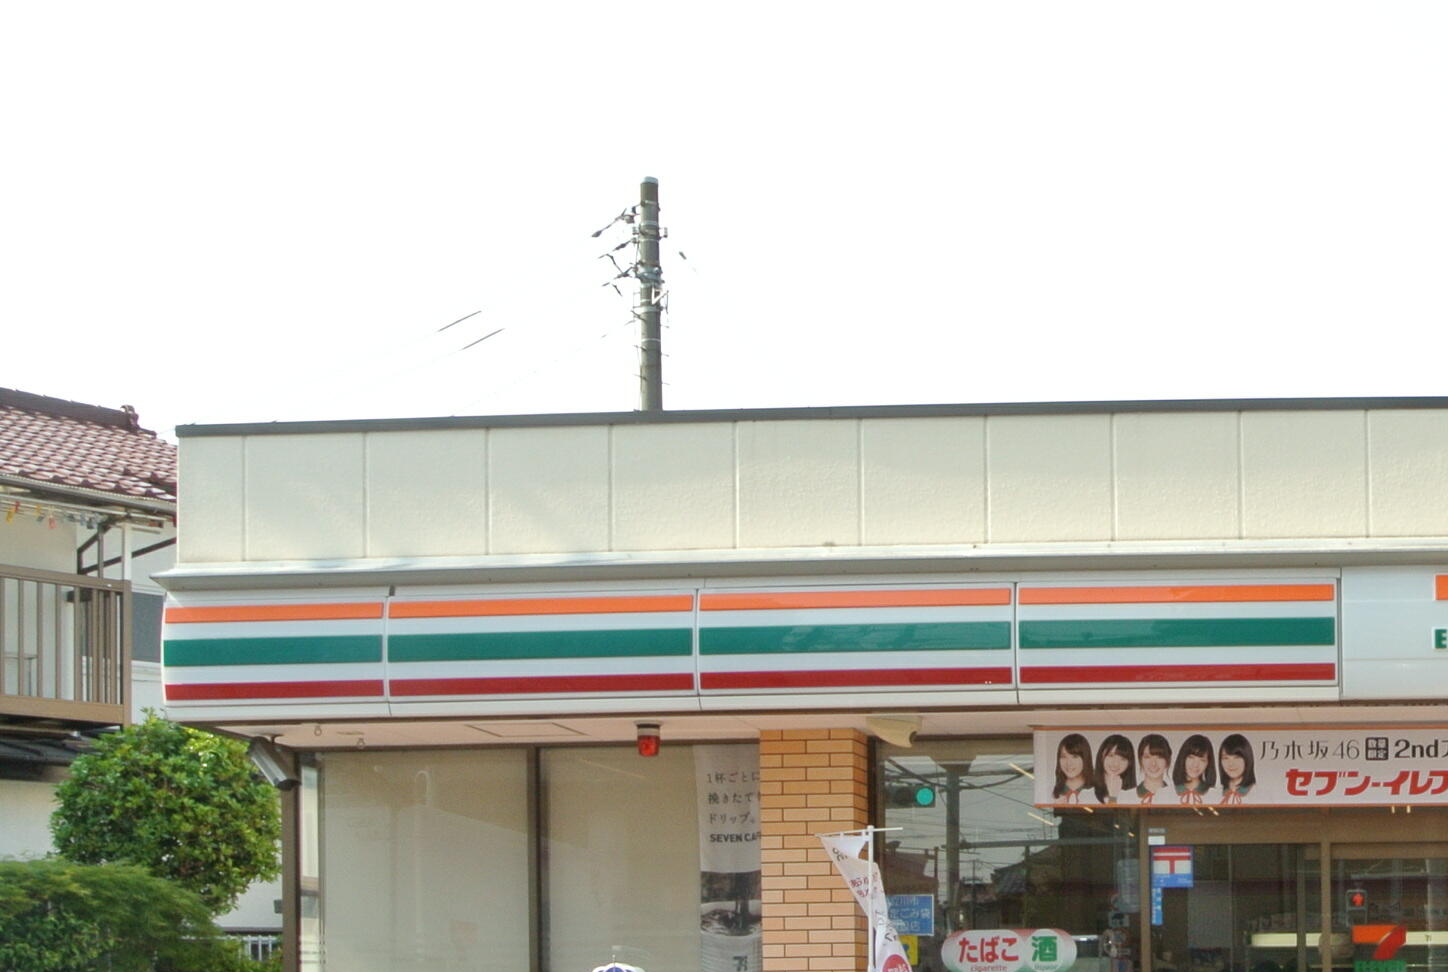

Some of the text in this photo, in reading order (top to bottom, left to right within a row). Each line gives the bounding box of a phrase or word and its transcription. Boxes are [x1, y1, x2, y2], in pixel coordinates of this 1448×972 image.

[1259, 739, 1360, 760] 乃木坂46
[708, 792, 760, 804] 挽きたて
[710, 833, 743, 843] SEVEN
[959, 936, 1057, 963] たばこ 酒
